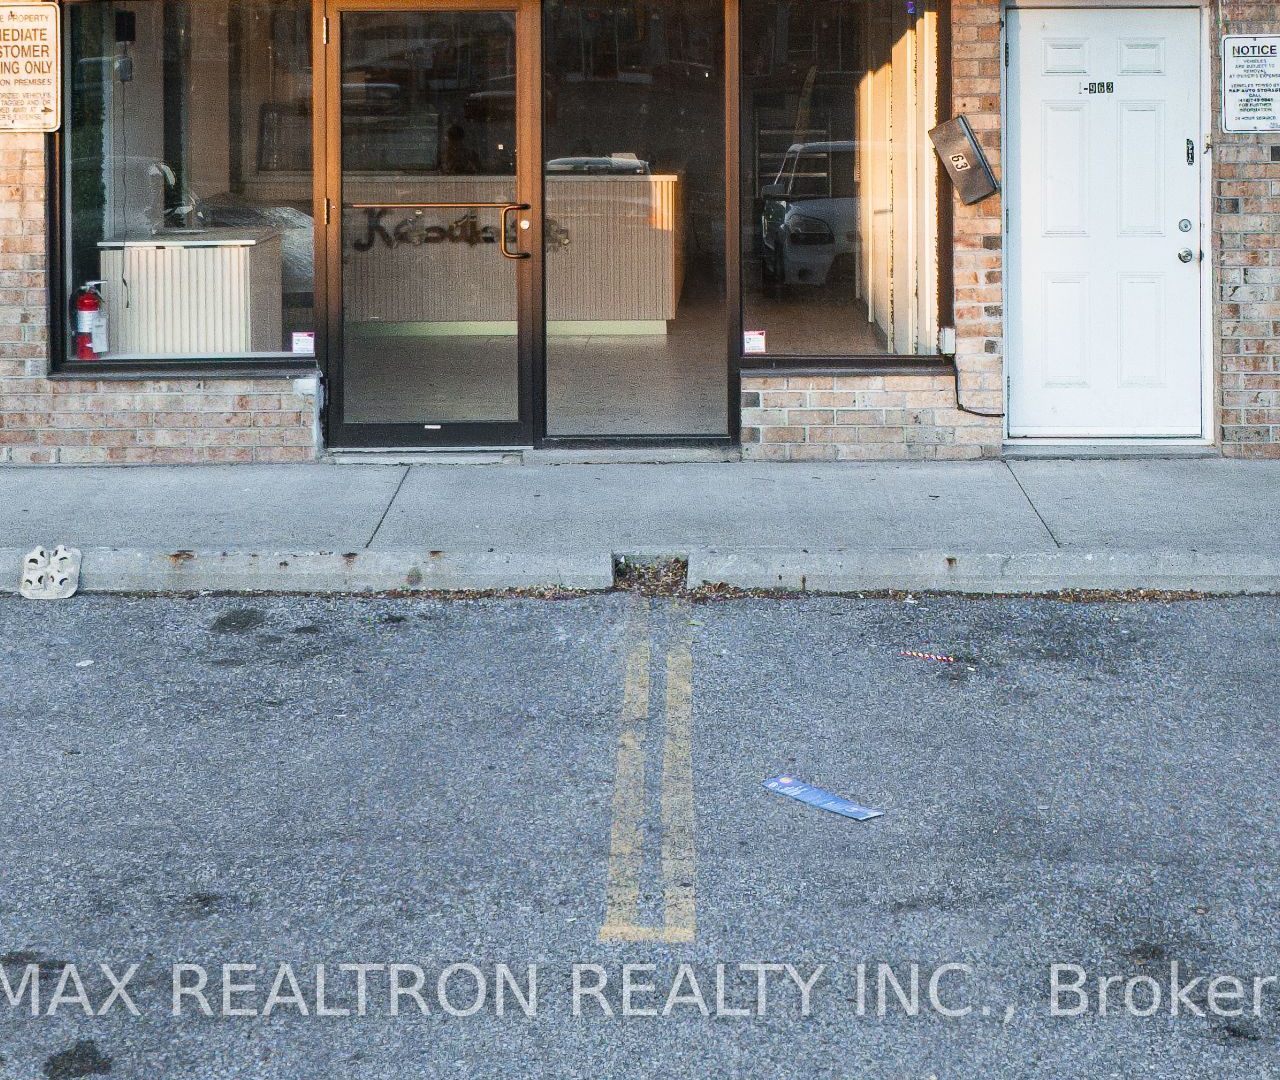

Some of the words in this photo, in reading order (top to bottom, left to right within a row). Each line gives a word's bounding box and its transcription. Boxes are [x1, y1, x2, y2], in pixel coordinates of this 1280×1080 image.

[1232, 45, 1278, 56] NOTICE
[24, 61, 53, 74] ONLY
[14, 78, 52, 86] PREMISES
[951, 154, 969, 170] 63
